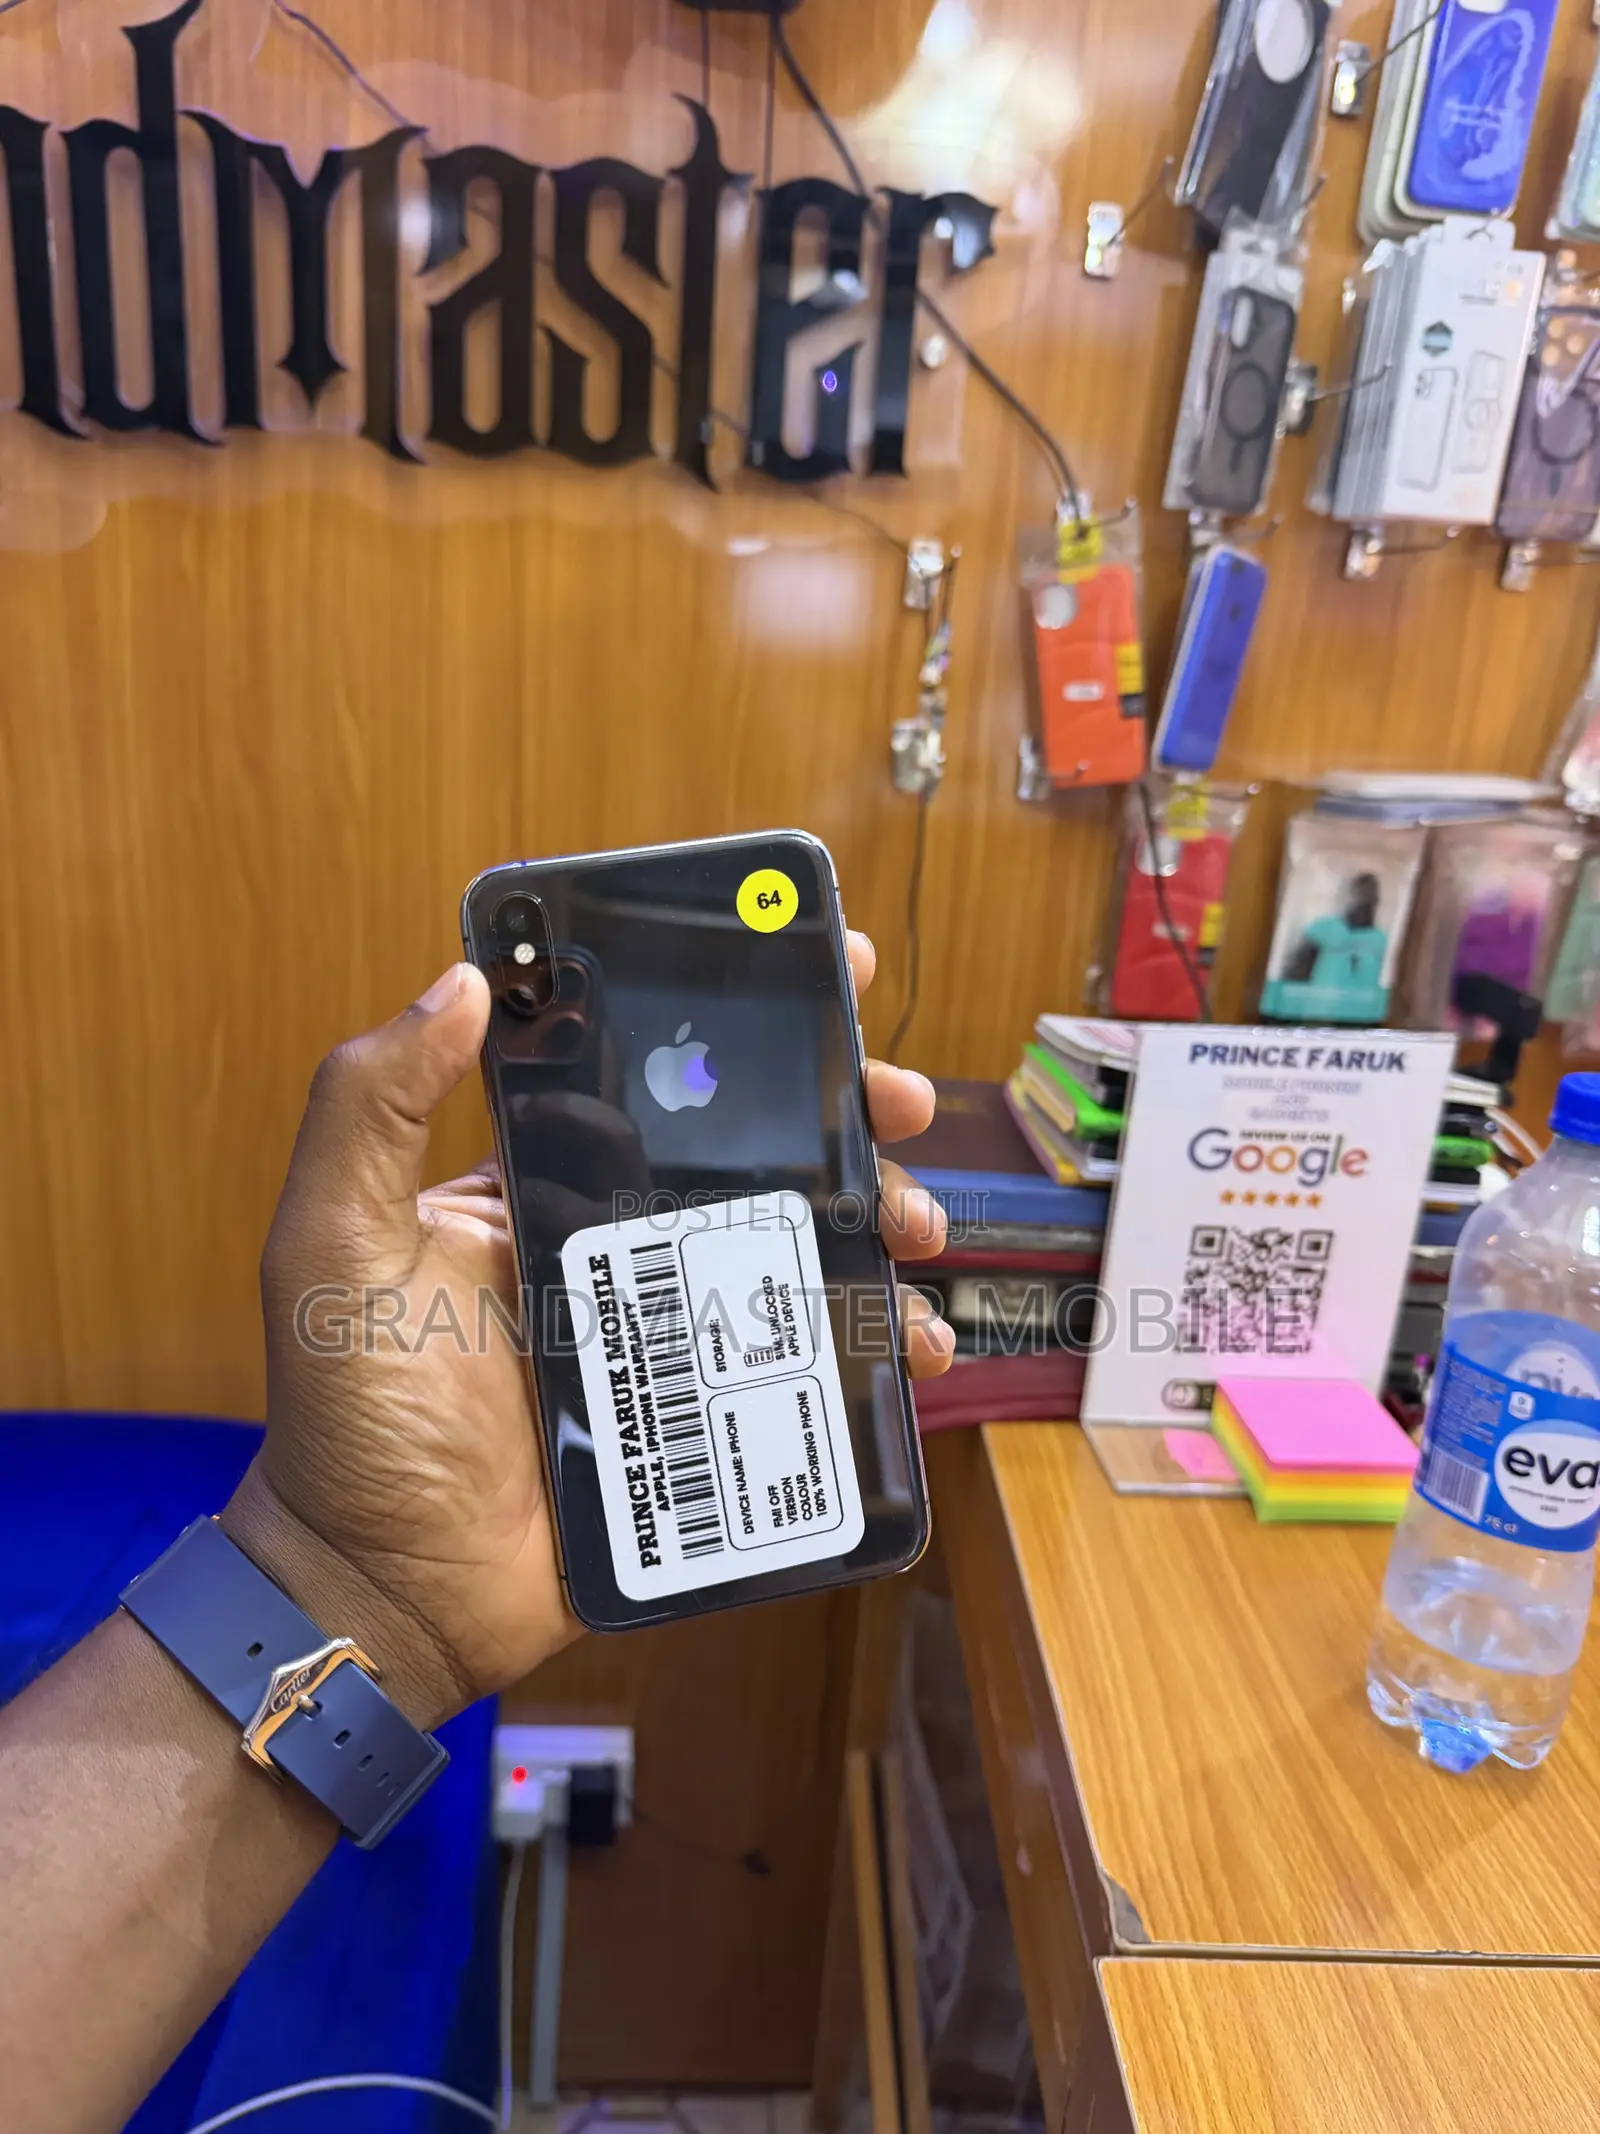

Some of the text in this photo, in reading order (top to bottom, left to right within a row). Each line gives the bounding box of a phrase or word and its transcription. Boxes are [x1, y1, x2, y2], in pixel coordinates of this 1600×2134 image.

[757, 890, 782, 910] 64
[1188, 1043, 1407, 1073] PRINCE FARUK
[1188, 1127, 1369, 1187] Google
[762, 1275, 786, 1360] SIM: UNLOCKED
[778, 1283, 801, 1356] APPLE DEVICE
[709, 1318, 727, 1373] STORAGE:
[588, 1253, 662, 1568] PRINCE FARUK MOBILE
[622, 1301, 671, 1511] APPLE, IPHONE WARRANTY
[724, 1411, 755, 1534] DEVICE NAME: IPHONE
[797, 1390, 828, 1517] 100% WORKING PHONE
[1503, 1445, 1600, 1490] eva
[767, 1484, 784, 1528] FMI OFF
[781, 1476, 799, 1526] VERSION
[796, 1473, 813, 1521] COLOUR
[270, 1667, 312, 1713] Cartier
